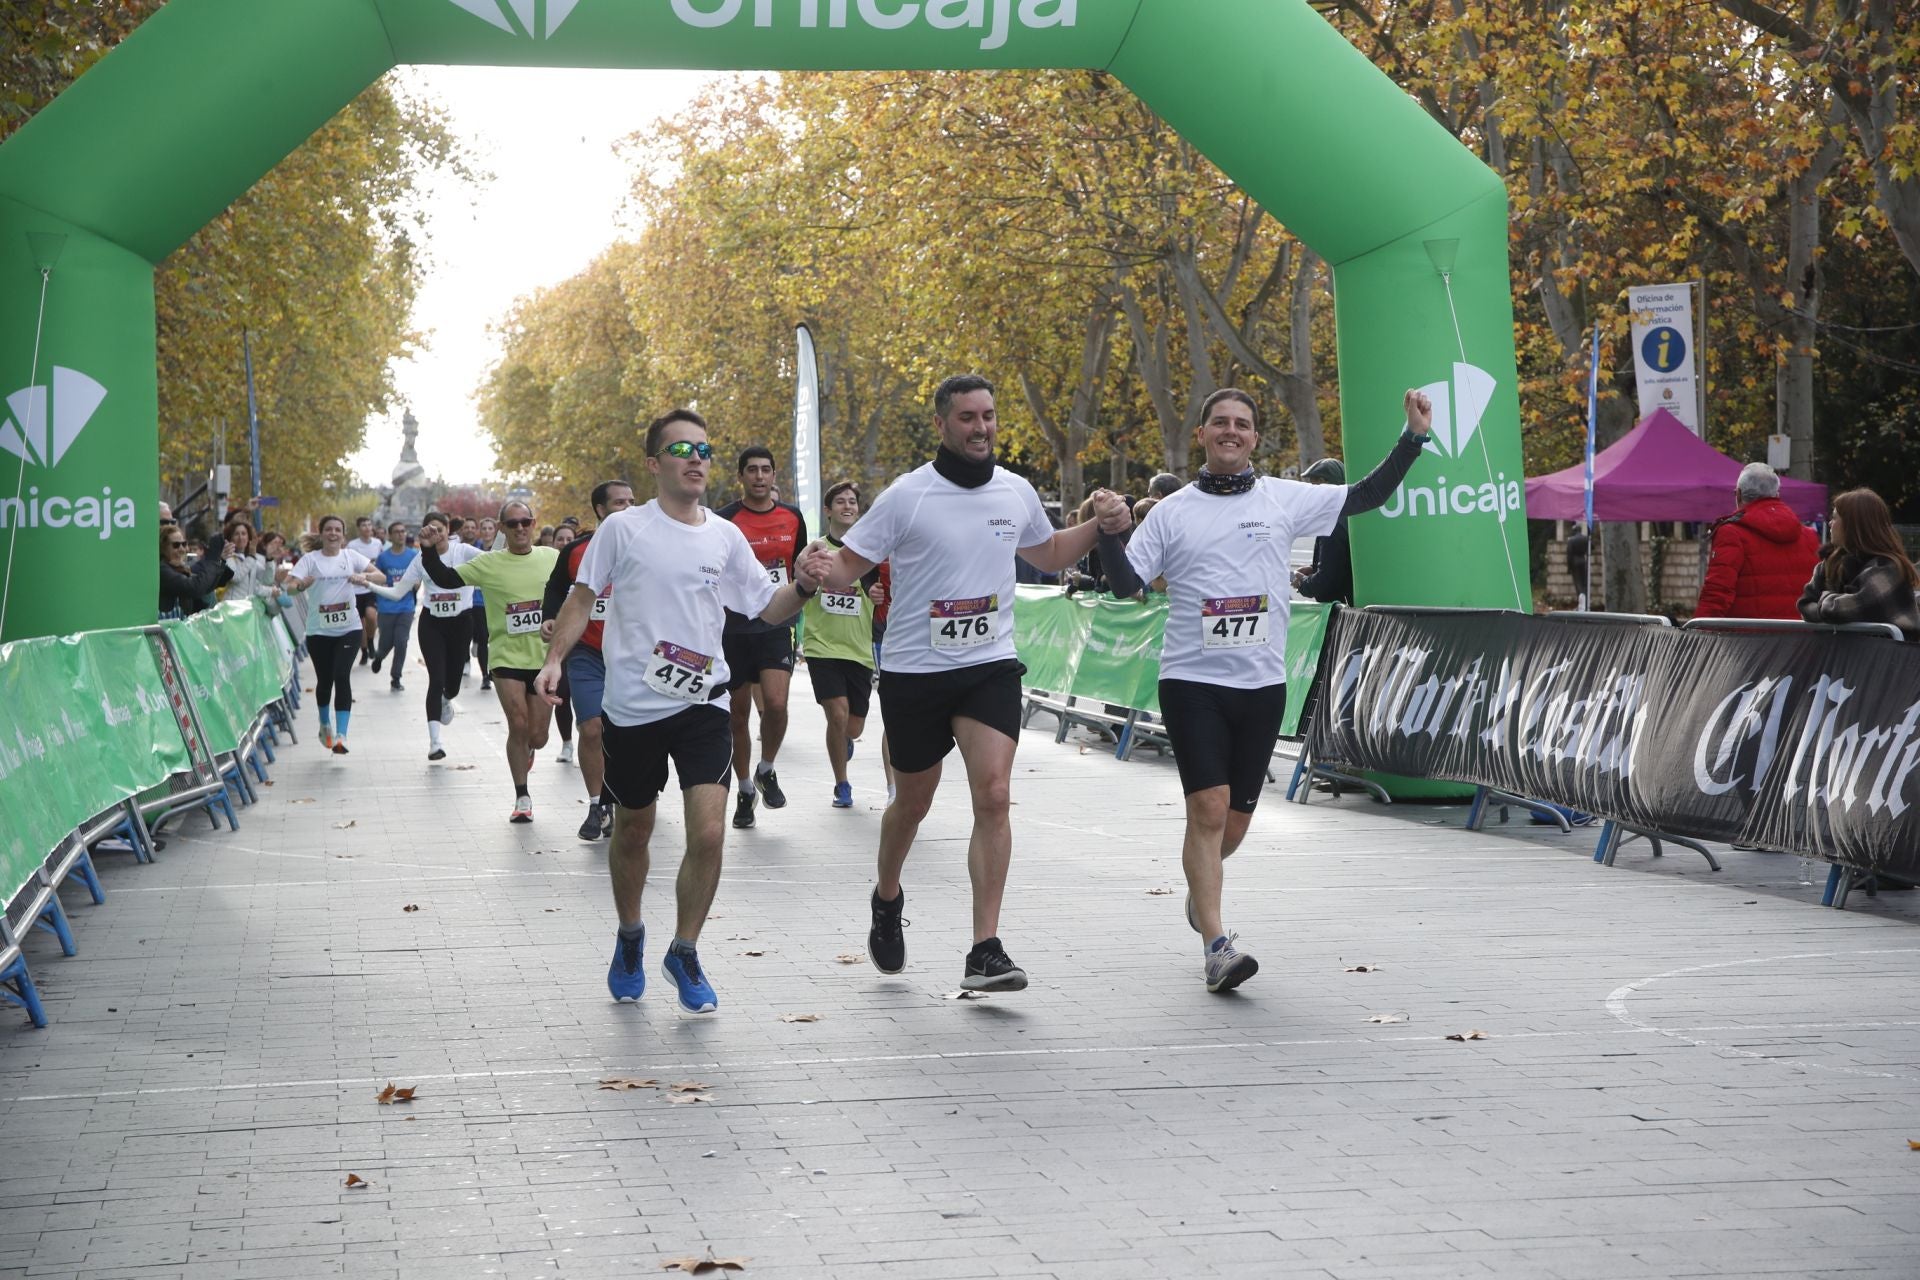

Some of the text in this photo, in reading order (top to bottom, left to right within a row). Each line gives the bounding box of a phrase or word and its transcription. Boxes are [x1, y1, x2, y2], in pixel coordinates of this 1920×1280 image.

[1637, 294, 1674, 303] Oficina de
[1380, 472, 1520, 523] Unicaja
[434, 602, 457, 613] 181
[827, 596, 855, 610] 342
[324, 612, 347, 624] 183
[512, 612, 541, 628] 340
[940, 616, 989, 639] 476
[1212, 615, 1259, 638] 477
[655, 663, 704, 694] 475
[1694, 674, 1793, 798] El
